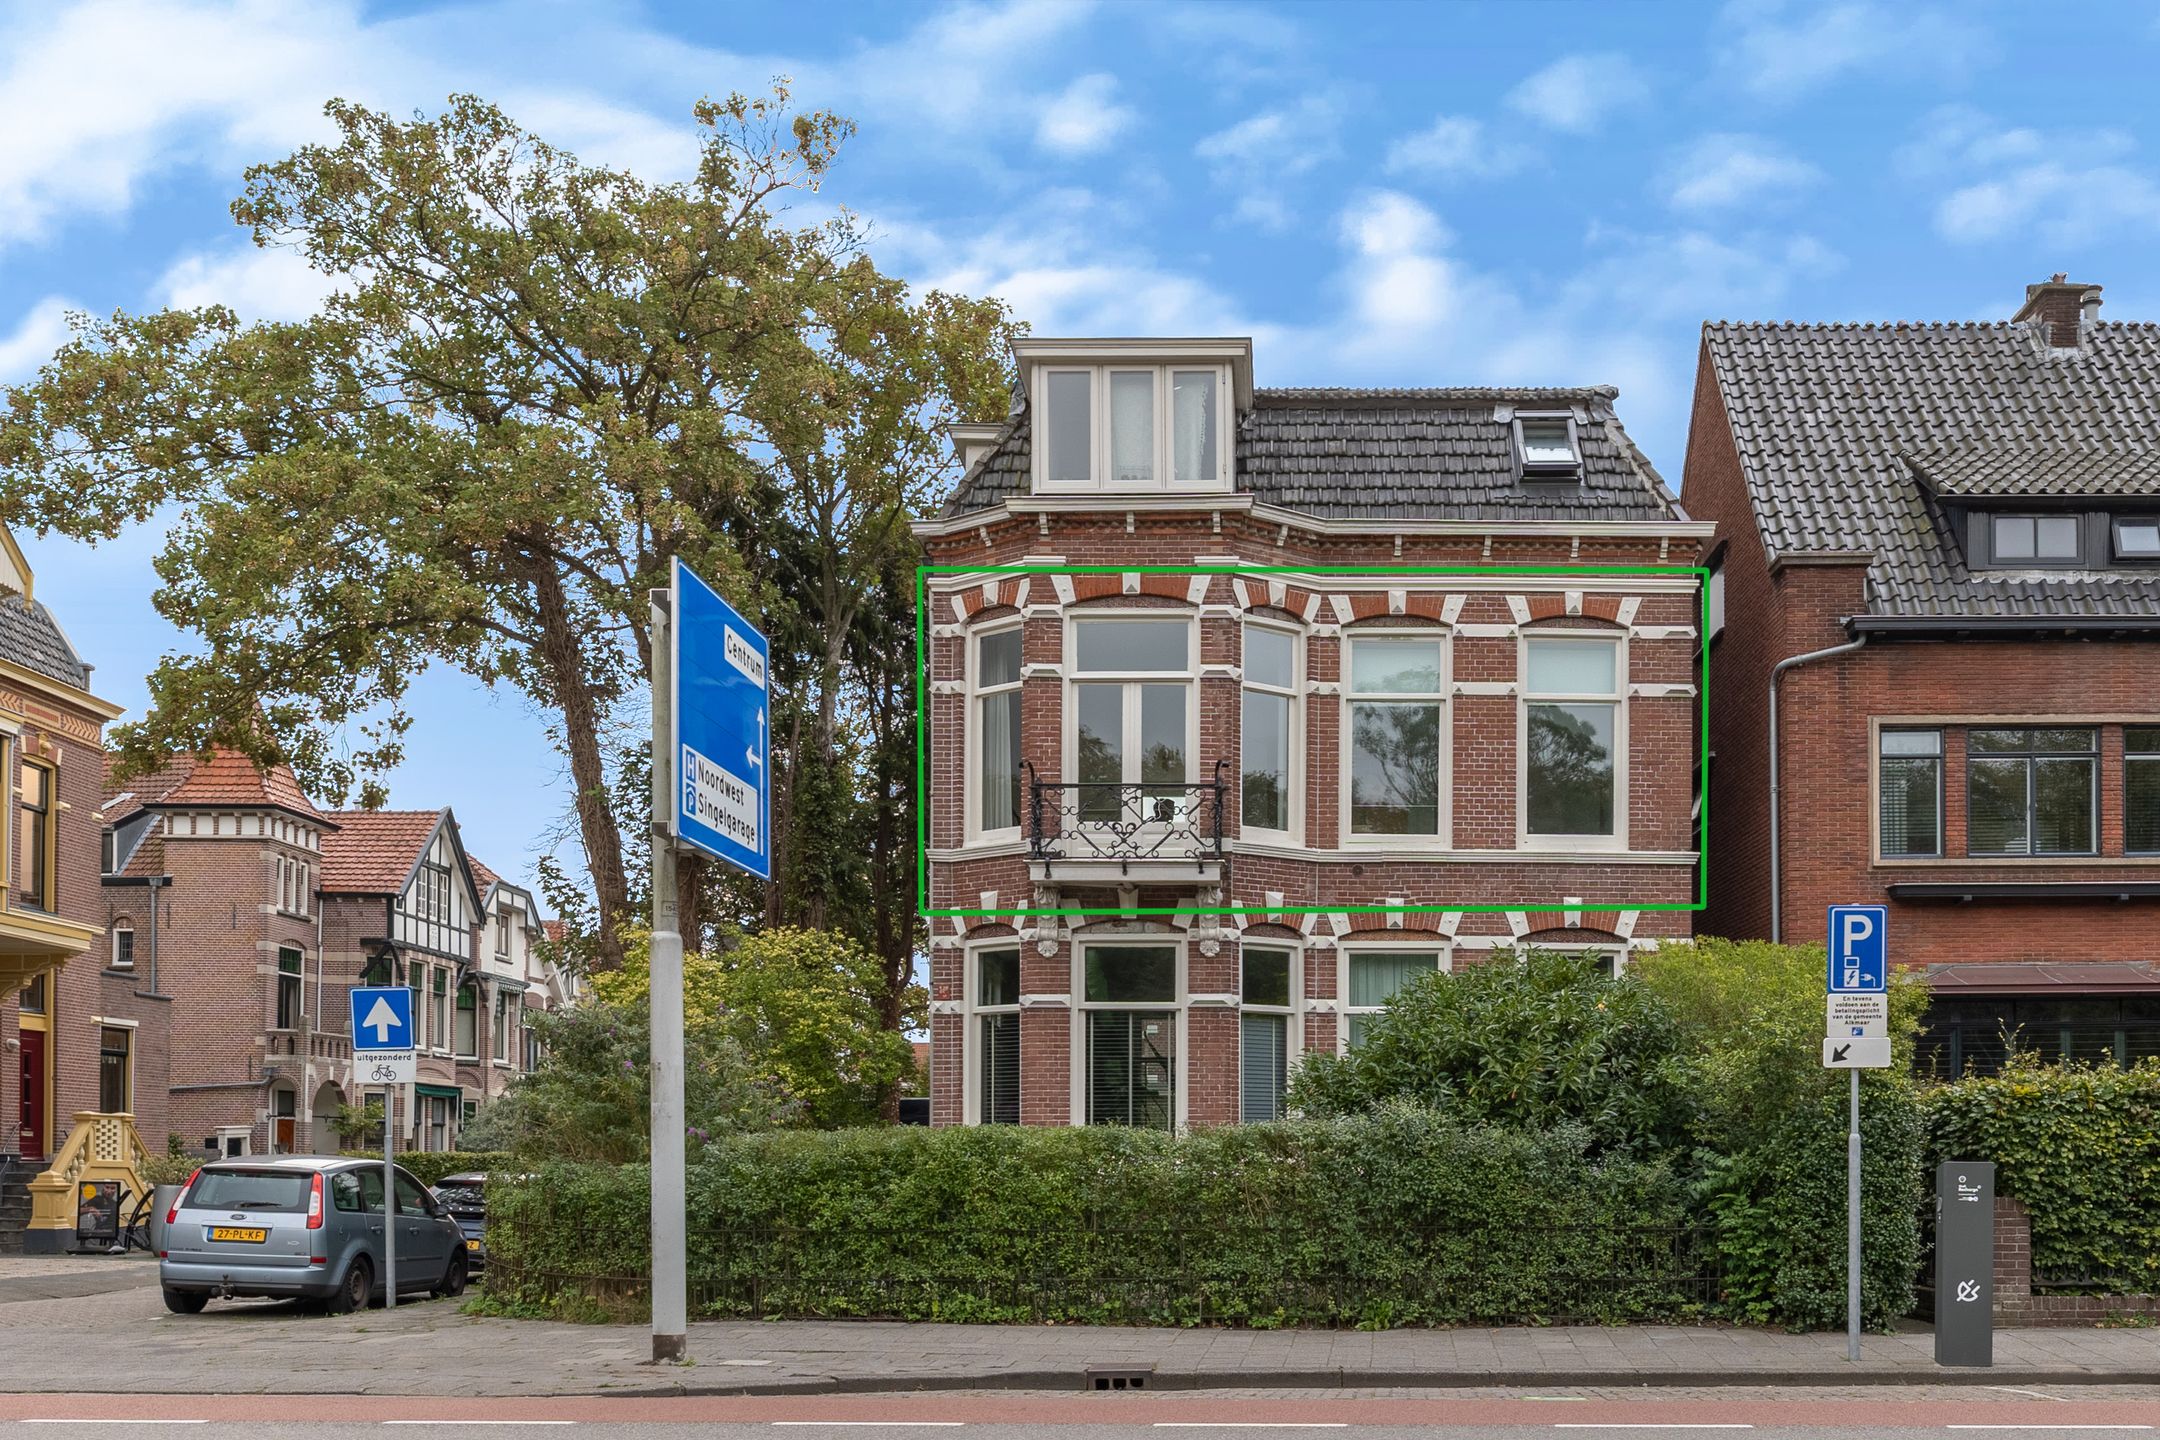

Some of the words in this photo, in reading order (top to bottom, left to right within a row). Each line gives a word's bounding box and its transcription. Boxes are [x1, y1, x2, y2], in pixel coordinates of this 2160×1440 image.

[727, 634, 762, 680] Centrum
[687, 754, 695, 779] H
[698, 760, 744, 806] Noordwest
[688, 795, 694, 811] P
[698, 793, 755, 845] Singelgarage
[1843, 914, 1873, 956] P
[357, 1053, 412, 1062] uitgezonderd
[217, 1229, 262, 1239] 27-PL-KF
